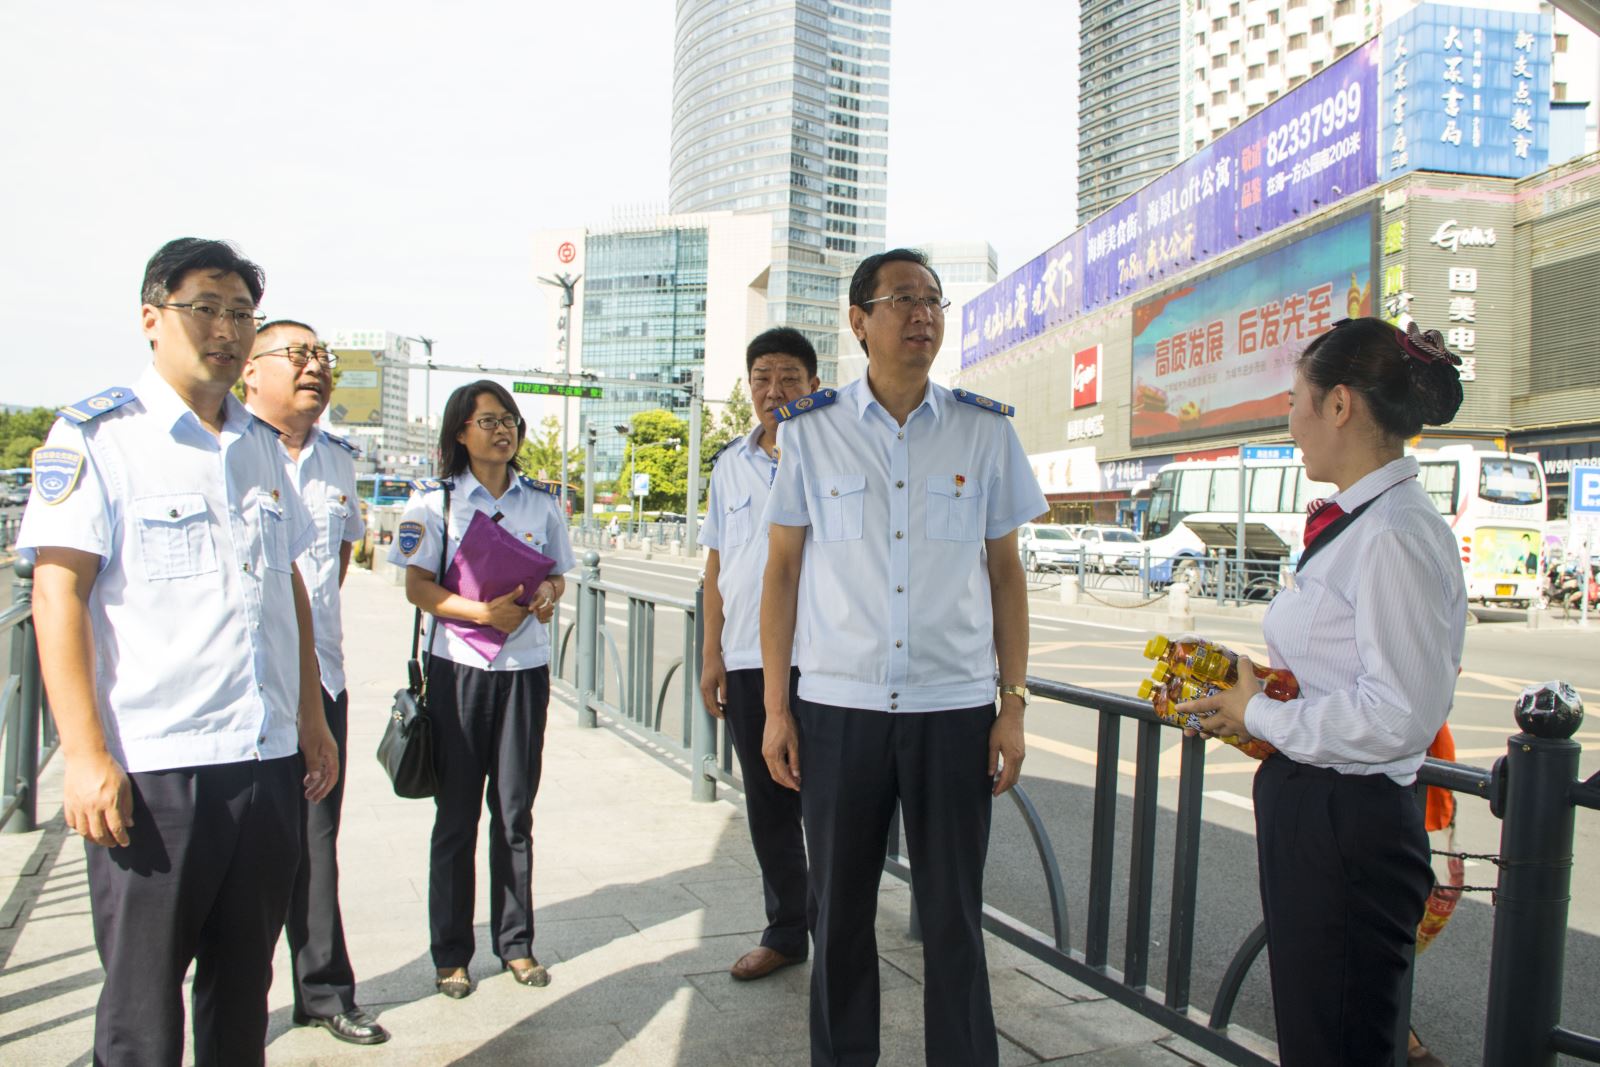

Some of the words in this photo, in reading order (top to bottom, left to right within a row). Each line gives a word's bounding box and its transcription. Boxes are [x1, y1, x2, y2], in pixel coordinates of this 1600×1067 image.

[1266, 82, 1361, 167] 82337999
[1510, 29, 1536, 159] 新支点教育
[1155, 320, 1224, 378] 高质发展
[1238, 282, 1333, 356] 后发先至
